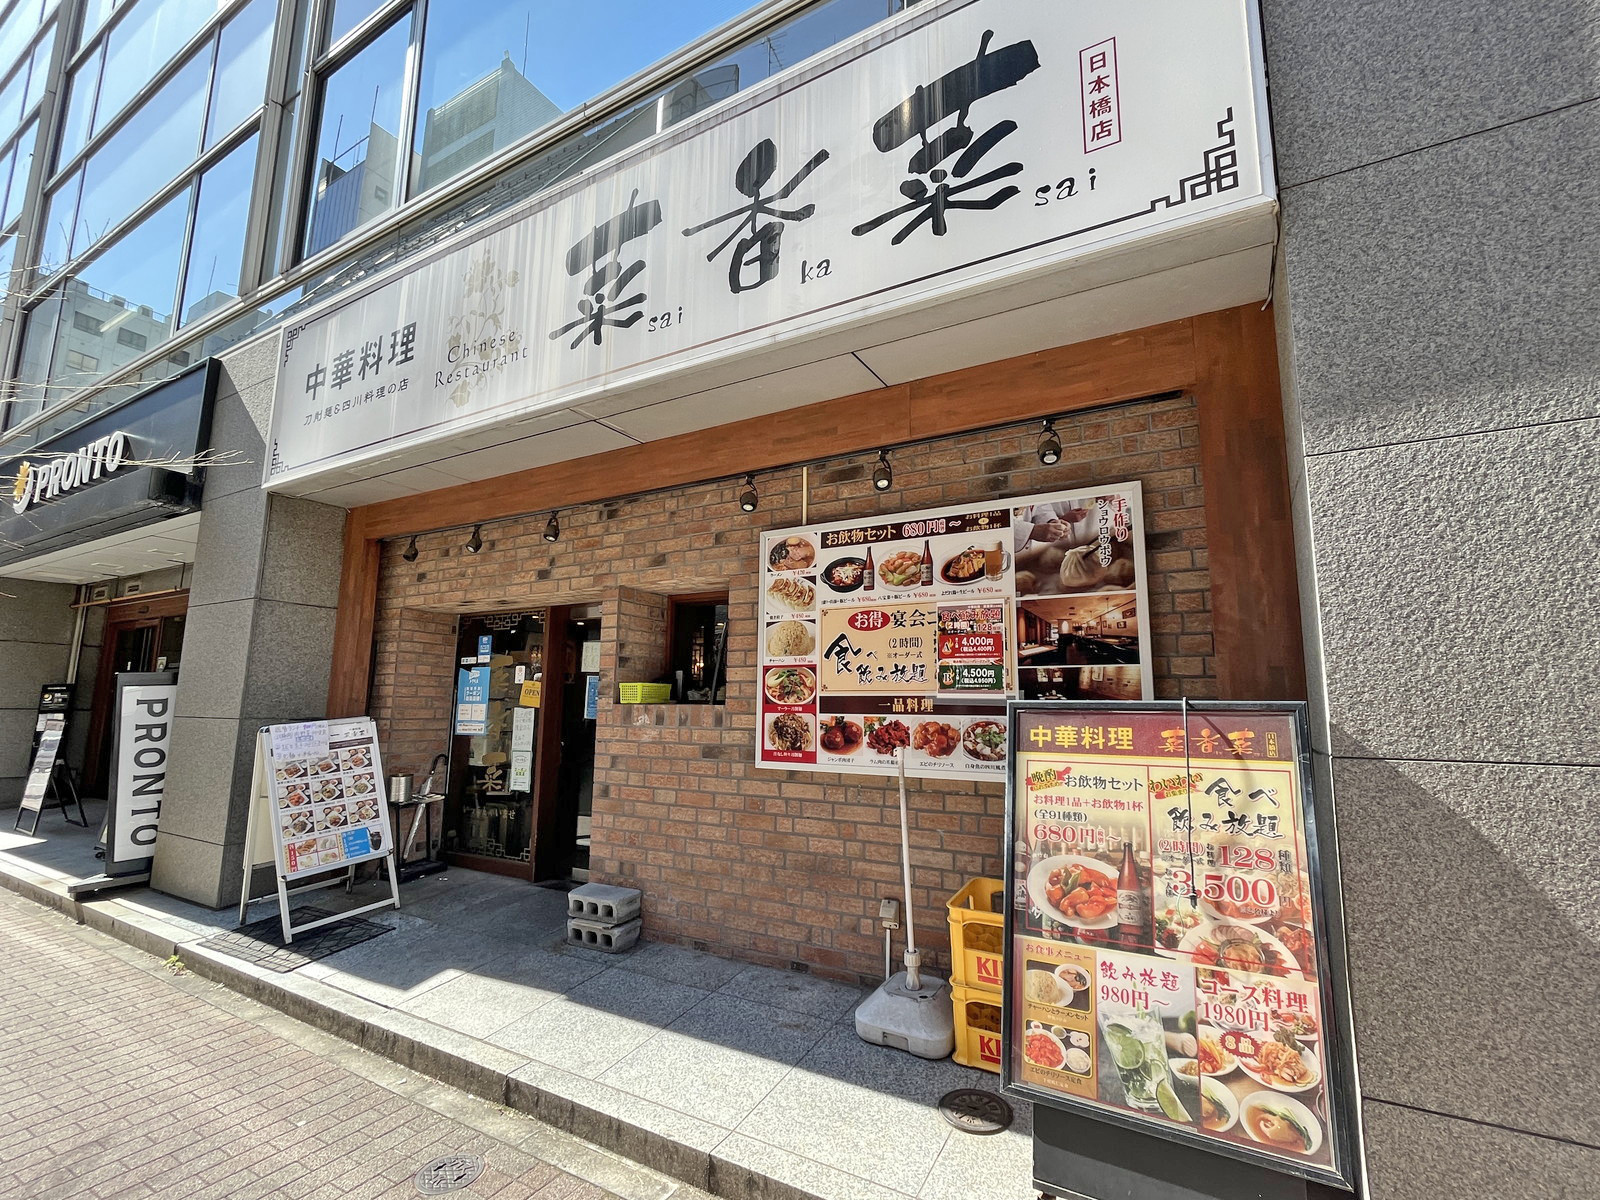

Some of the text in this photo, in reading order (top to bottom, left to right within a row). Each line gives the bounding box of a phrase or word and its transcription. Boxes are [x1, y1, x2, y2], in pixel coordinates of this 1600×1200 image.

[1088, 51, 1114, 144] 日本橋店
[550, 30, 1040, 349] 菜香菜
[1034, 168, 1098, 207] sai
[799, 260, 833, 286] ka
[648, 306, 683, 333] sai
[305, 321, 417, 400] 中華料理
[447, 330, 517, 364] Chinese
[434, 346, 529, 389] Restaurant
[33, 430, 126, 504] PRONTO
[1112, 497, 1129, 542] 手作り
[826, 525, 897, 546] お飲物セット
[854, 611, 884, 629] お得
[824, 633, 878, 675] 食べ
[888, 637, 923, 649] (2時間)
[856, 663, 928, 685] 飲み放題
[524, 688, 540, 697] OPEN
[878, 697, 934, 713] 一品料理
[1029, 725, 1134, 750] 中華料理
[130, 697, 169, 847] PRONTO
[1065, 774, 1144, 792] お飲物セット
[1149, 771, 1204, 794] わいわい
[1204, 777, 1280, 808] 食べ
[1034, 808, 1088, 823] (全91種類)
[1167, 807, 1285, 839] 飲み放題
[1218, 845, 1275, 871] 128
[1025, 943, 1093, 961] お食事メニュー
[1100, 960, 1181, 992] 飲み放題
[1200, 978, 1309, 1014] コース料理
[1224, 1034, 1256, 1056] 8品
